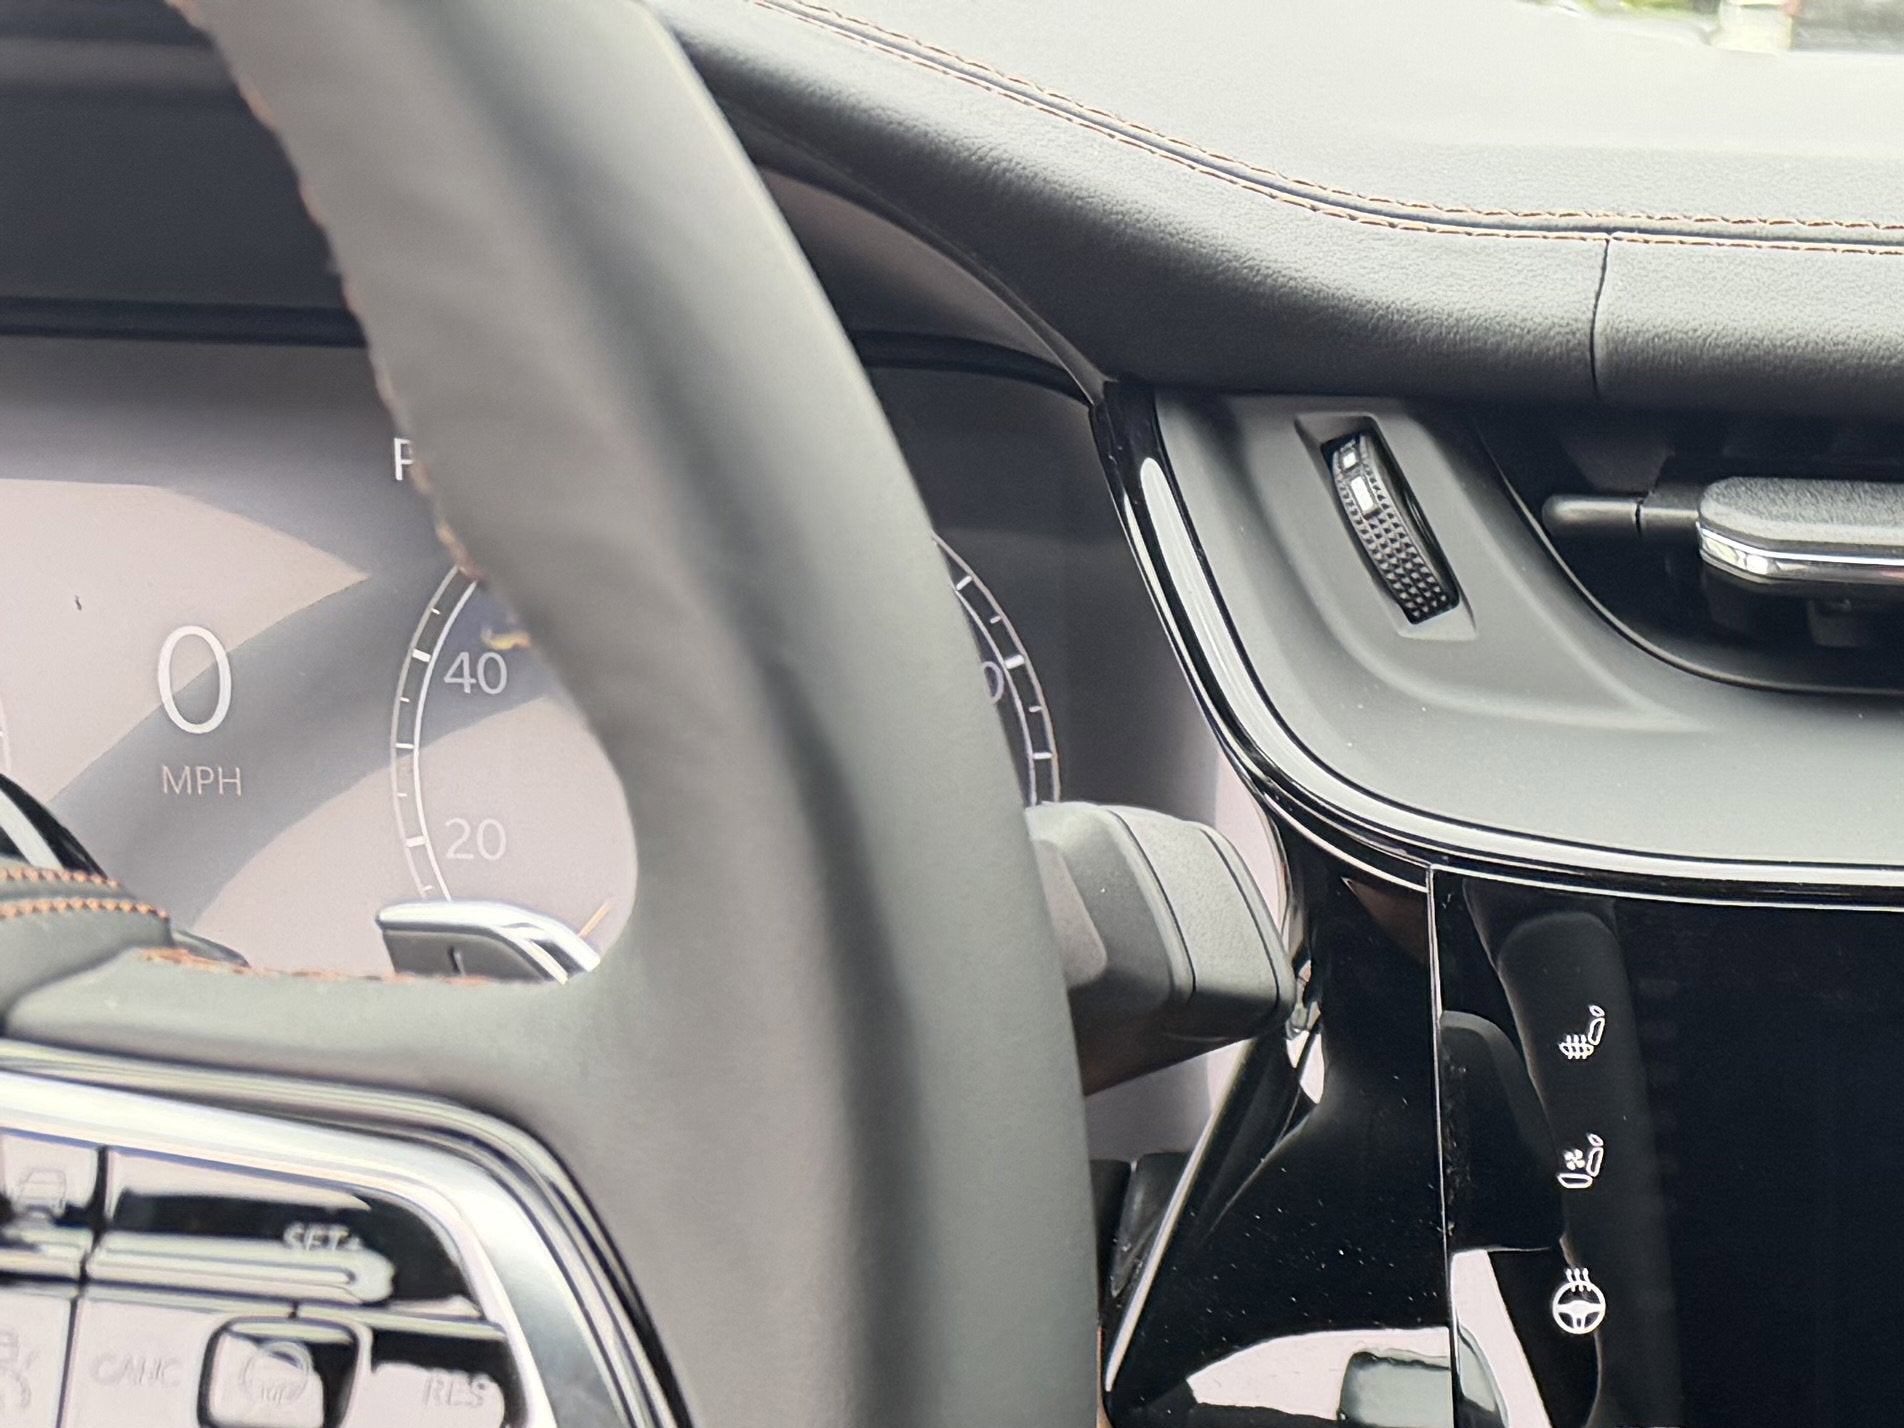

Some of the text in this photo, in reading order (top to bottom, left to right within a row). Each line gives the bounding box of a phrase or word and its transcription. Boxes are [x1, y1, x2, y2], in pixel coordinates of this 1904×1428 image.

[157, 624, 232, 734] 0
[444, 651, 507, 695] 40
[162, 765, 243, 797] MPH
[445, 819, 506, 861] 20
